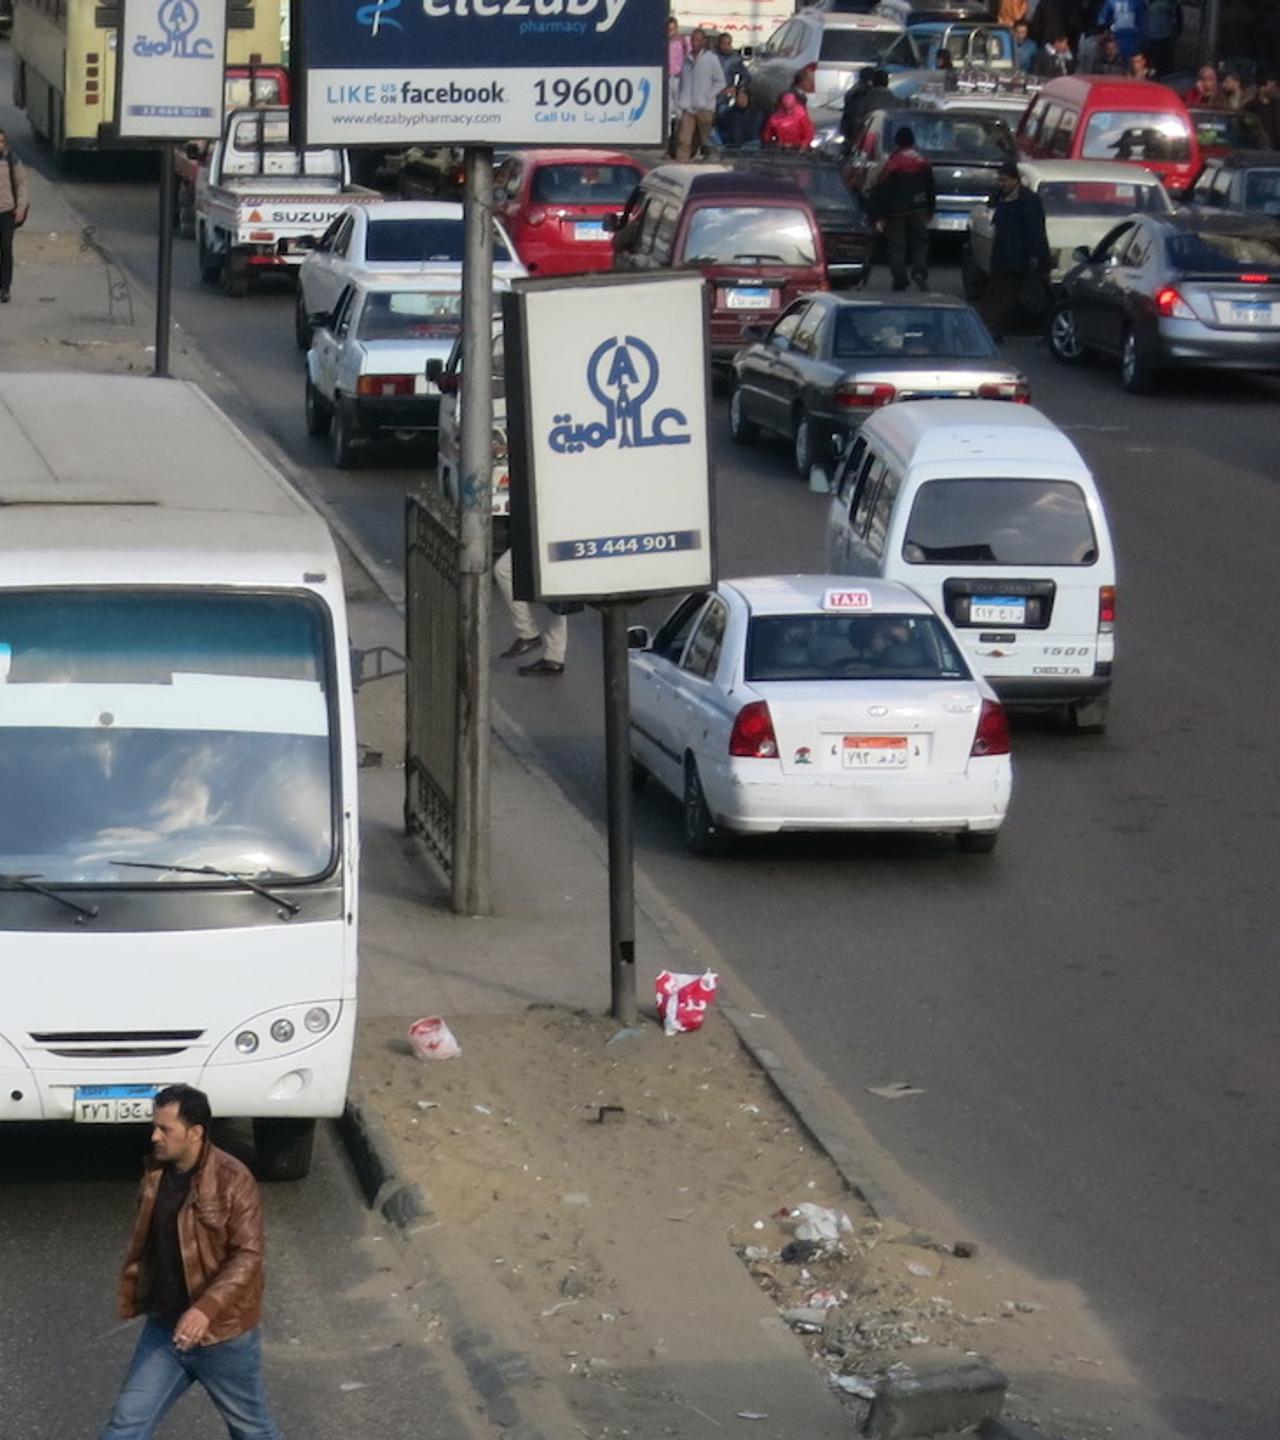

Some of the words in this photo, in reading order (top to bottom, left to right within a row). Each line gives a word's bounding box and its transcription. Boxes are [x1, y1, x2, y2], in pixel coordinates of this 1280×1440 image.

[520, 18, 587, 34] pharmacy
[327, 86, 376, 104] LIKE
[381, 85, 397, 93] US
[400, 80, 505, 104] facebook
[533, 78, 633, 107] 19600
[380, 95, 397, 104] ON
[332, 112, 501, 126] www.elezabypharmacy.com
[535, 111, 558, 122] Call
[561, 111, 577, 122] Us
[272, 211, 338, 222] SUZUK
[574, 542, 597, 557] 33
[601, 538, 638, 554] 444
[643, 534, 677, 550] 901
[831, 594, 867, 606] TAXI
[1032, 666, 1081, 674] DELTA
[81, 1102, 110, 1119] ٣٧٦
